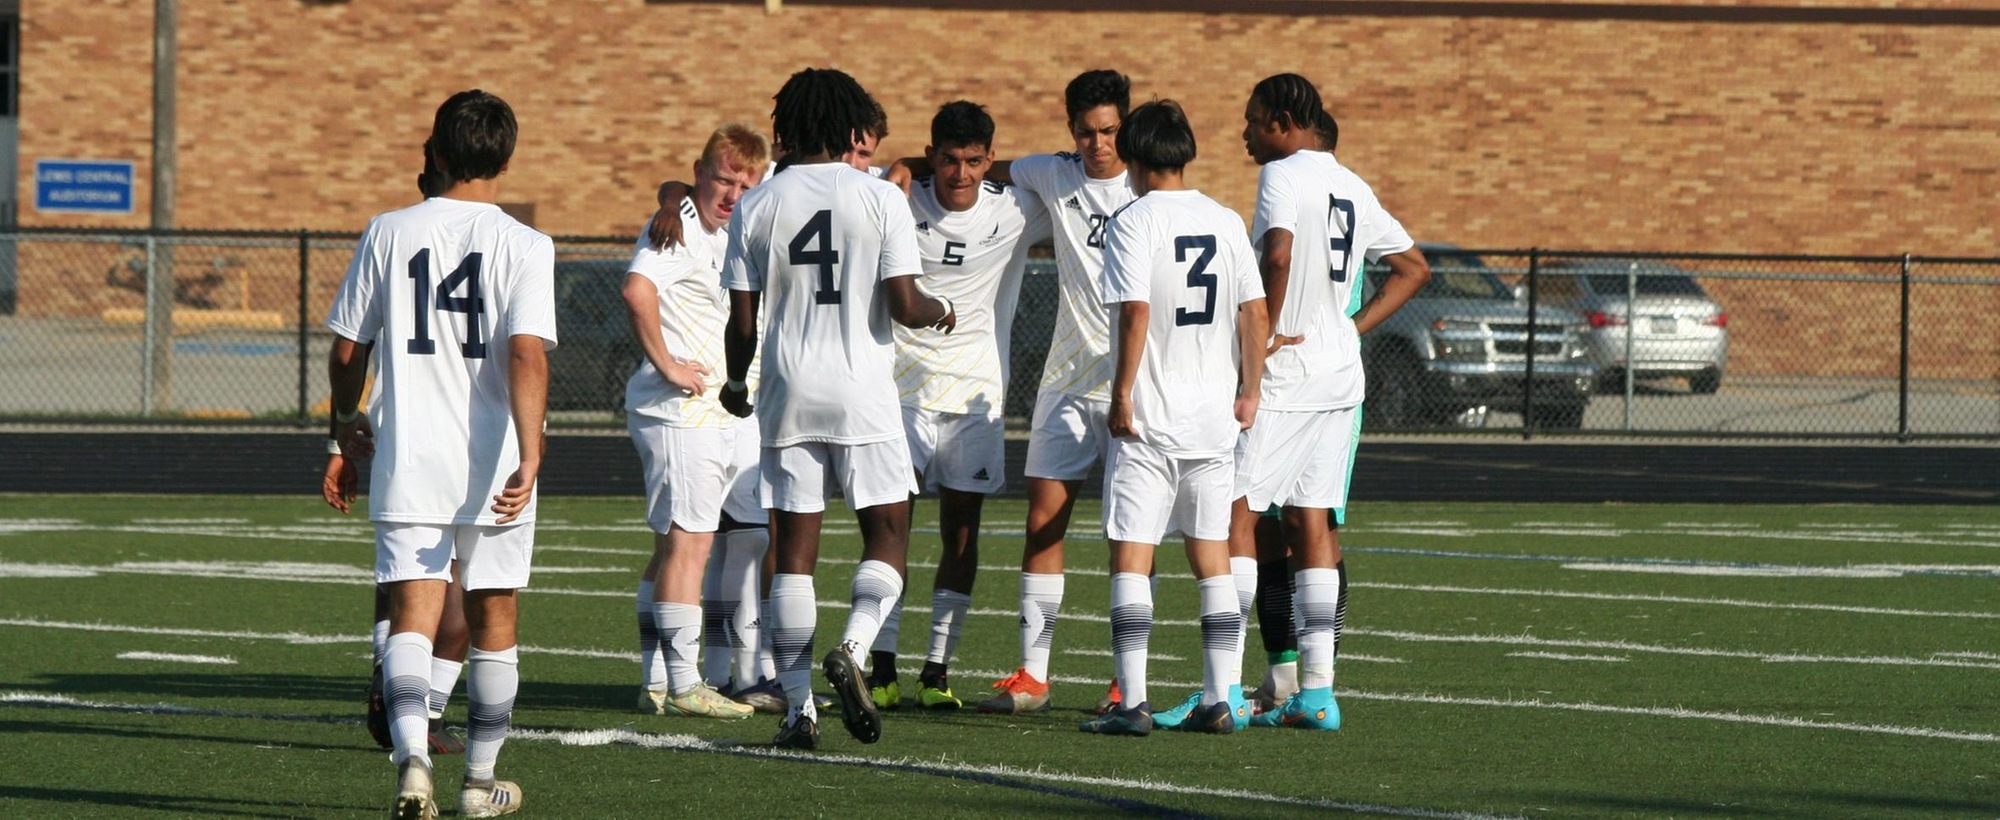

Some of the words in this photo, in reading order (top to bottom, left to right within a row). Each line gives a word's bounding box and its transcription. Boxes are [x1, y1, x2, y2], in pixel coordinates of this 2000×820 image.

[788, 209, 841, 305] 4
[942, 240, 966, 266] 5
[1174, 234, 1217, 326] 3
[1328, 193, 1355, 282] 9
[407, 247, 486, 359] 14
